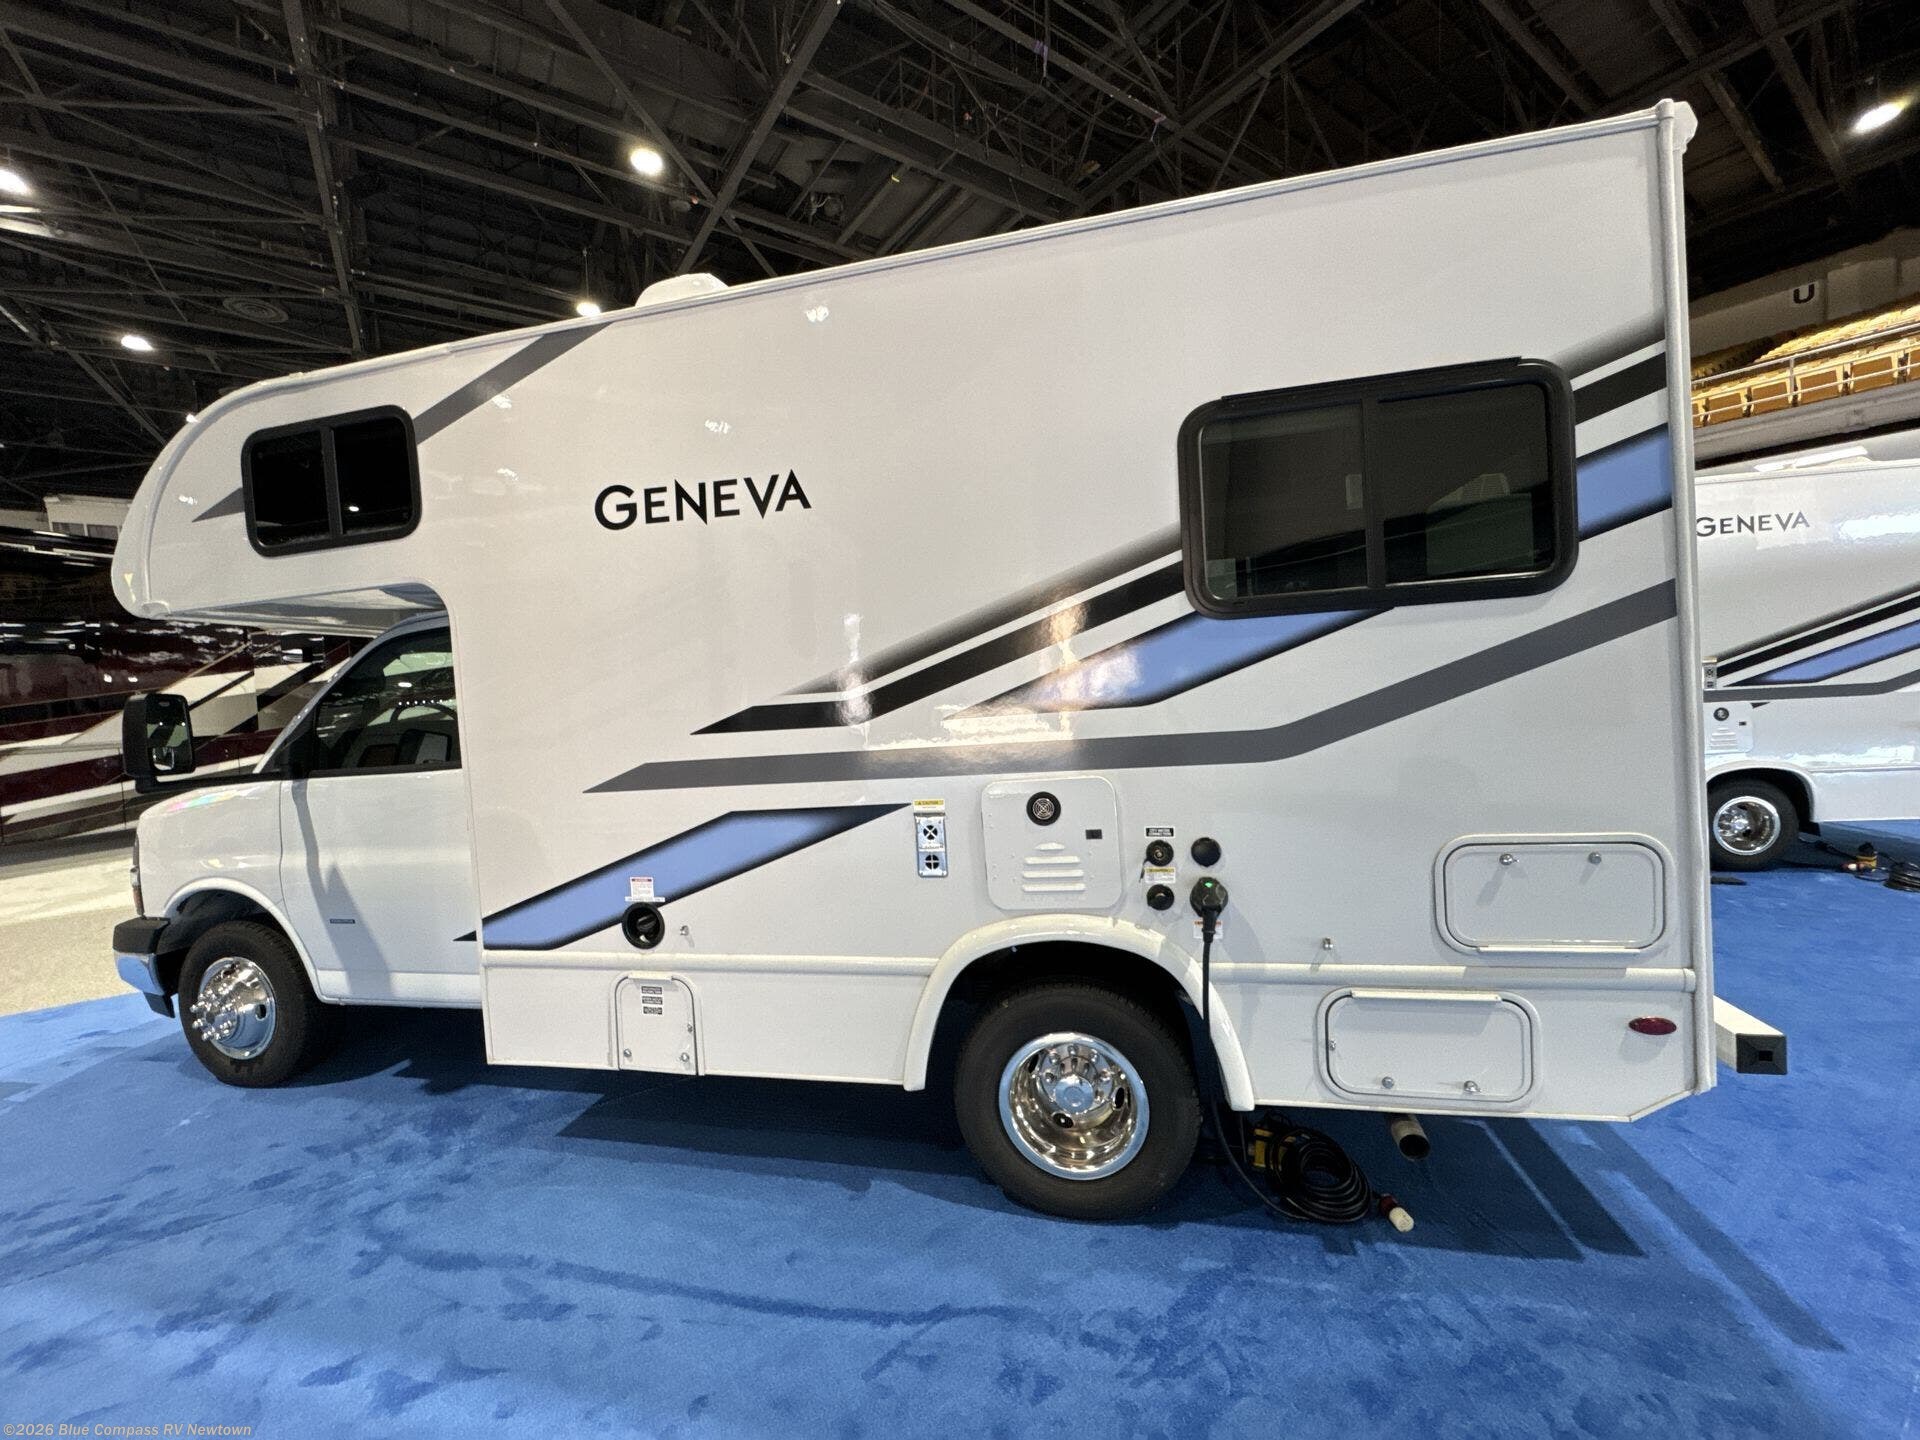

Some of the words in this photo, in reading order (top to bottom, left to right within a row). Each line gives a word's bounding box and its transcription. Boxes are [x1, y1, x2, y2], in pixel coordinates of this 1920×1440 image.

[1793, 283, 1815, 304] U
[594, 468, 812, 531] GENEVA
[1696, 509, 1810, 537] GENEVA
